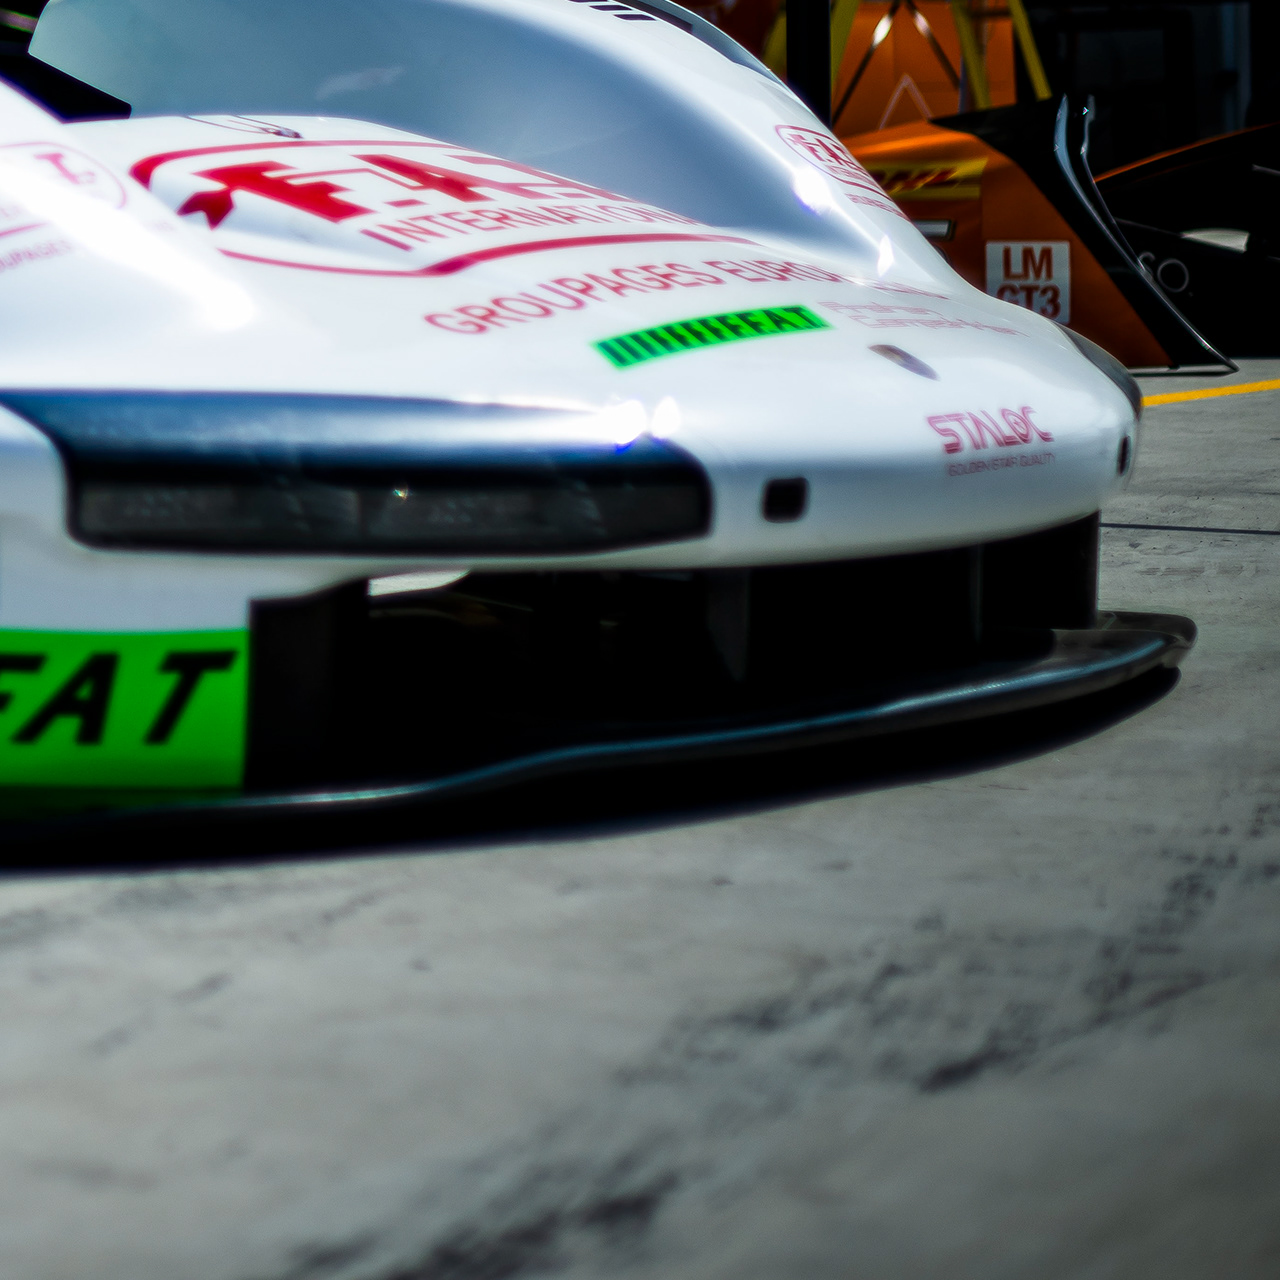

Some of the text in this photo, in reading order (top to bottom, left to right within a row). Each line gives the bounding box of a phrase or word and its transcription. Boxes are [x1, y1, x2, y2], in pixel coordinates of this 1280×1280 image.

[1003, 246, 1053, 280] LM
[422, 258, 728, 337] GROUPAGES
[997, 284, 1061, 319] GT3
